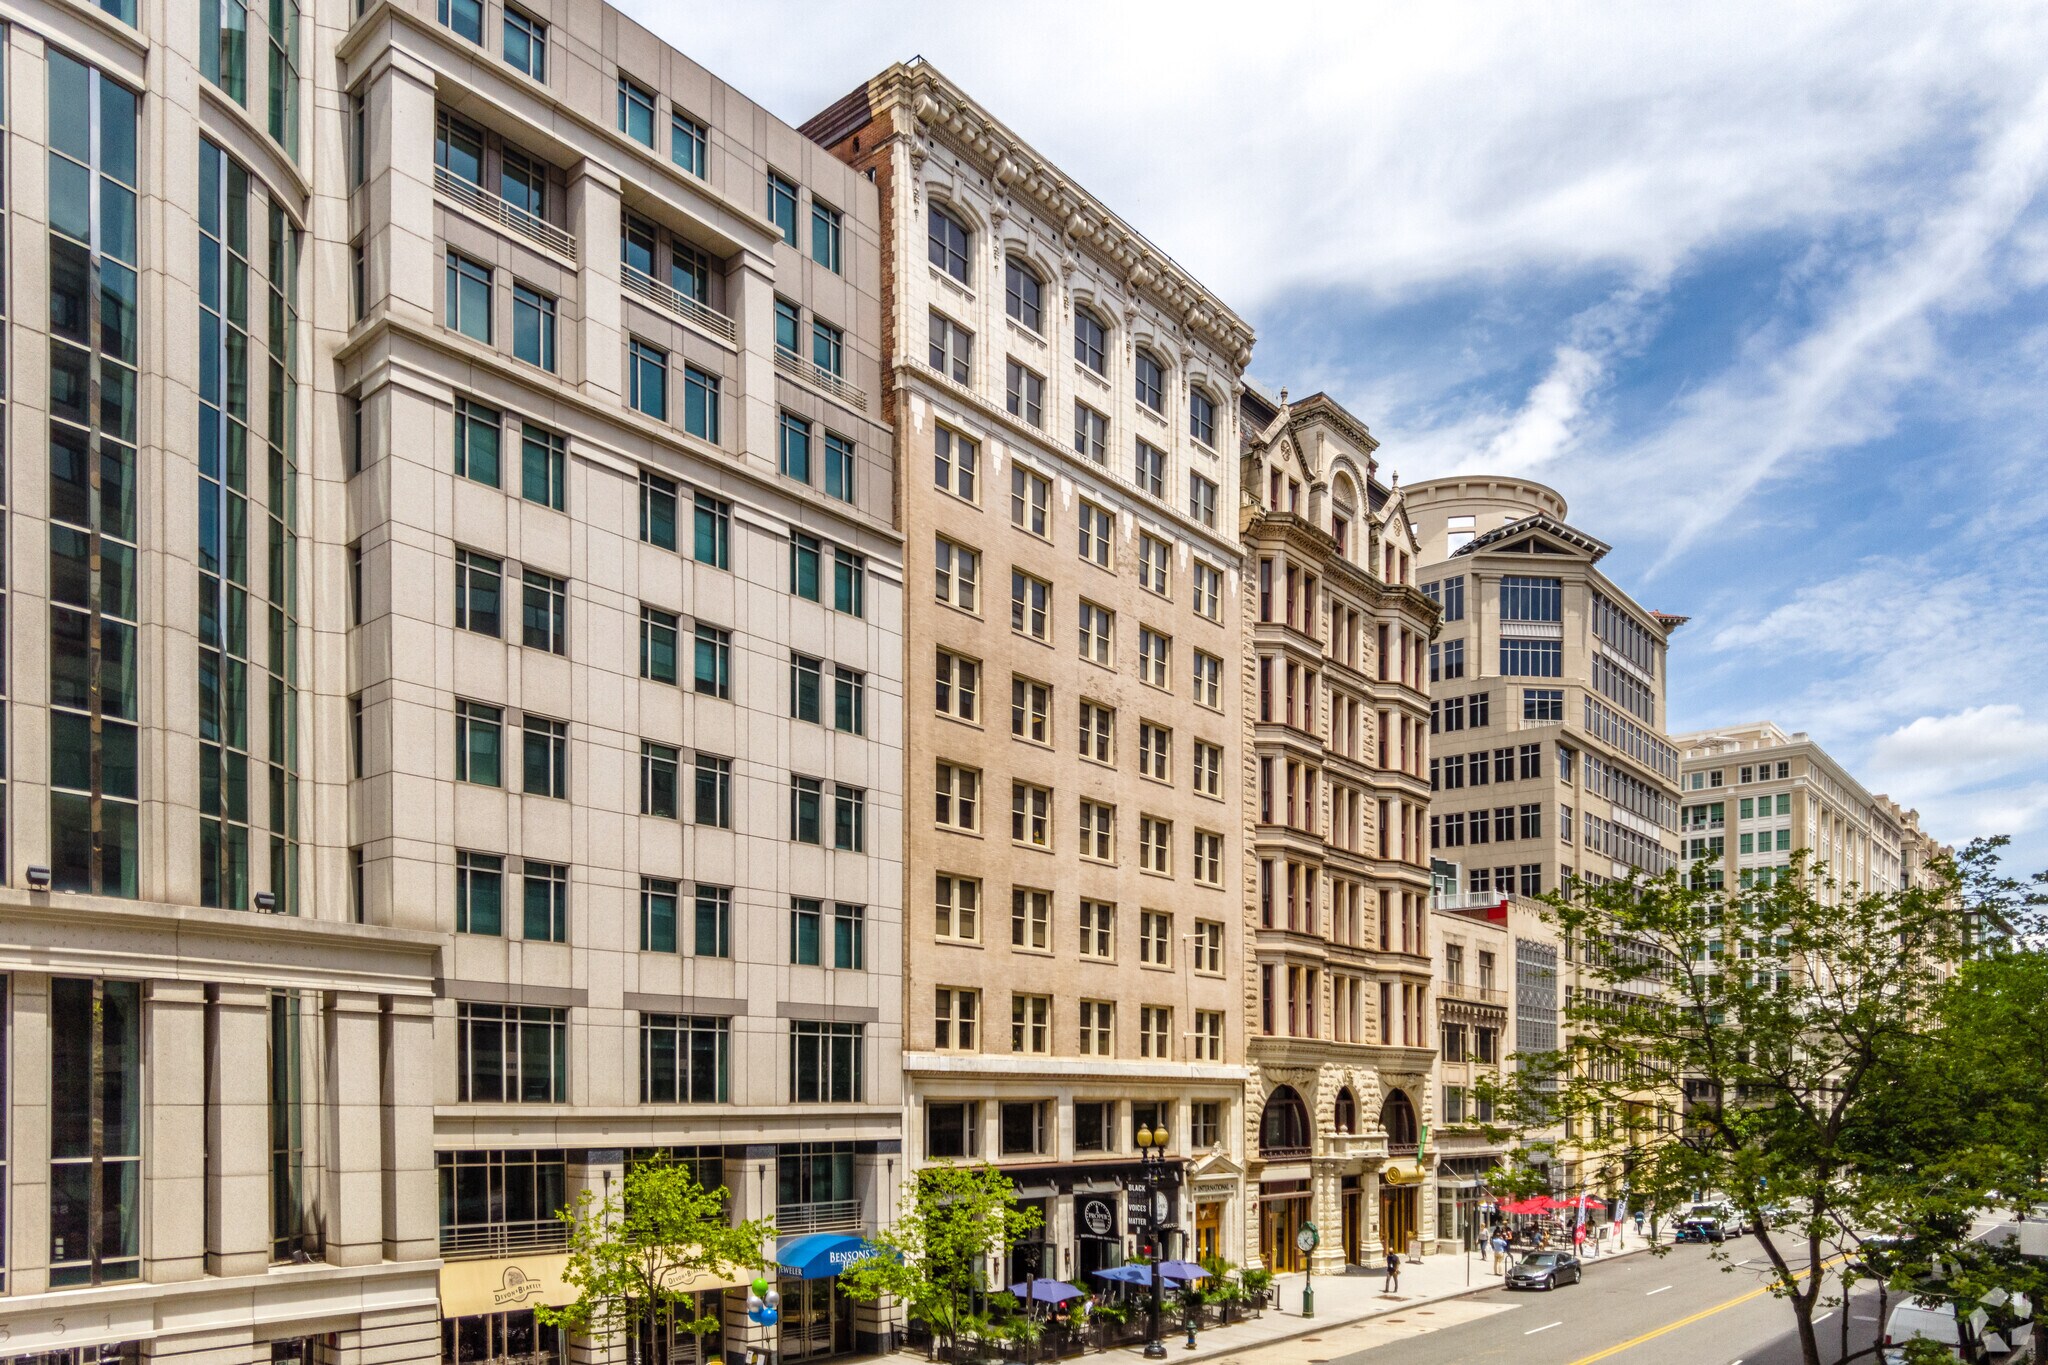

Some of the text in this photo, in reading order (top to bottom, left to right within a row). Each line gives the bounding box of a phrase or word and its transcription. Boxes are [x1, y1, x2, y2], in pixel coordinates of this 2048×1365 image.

[1128, 1184, 1146, 1192] BLACK
[1129, 1204, 1147, 1212] VOICES
[1129, 1218, 1147, 1226] MATTER
[829, 1249, 870, 1264] BENSONS
[495, 1290, 515, 1302] DEVON
[518, 1283, 541, 1294] BLAKELY
